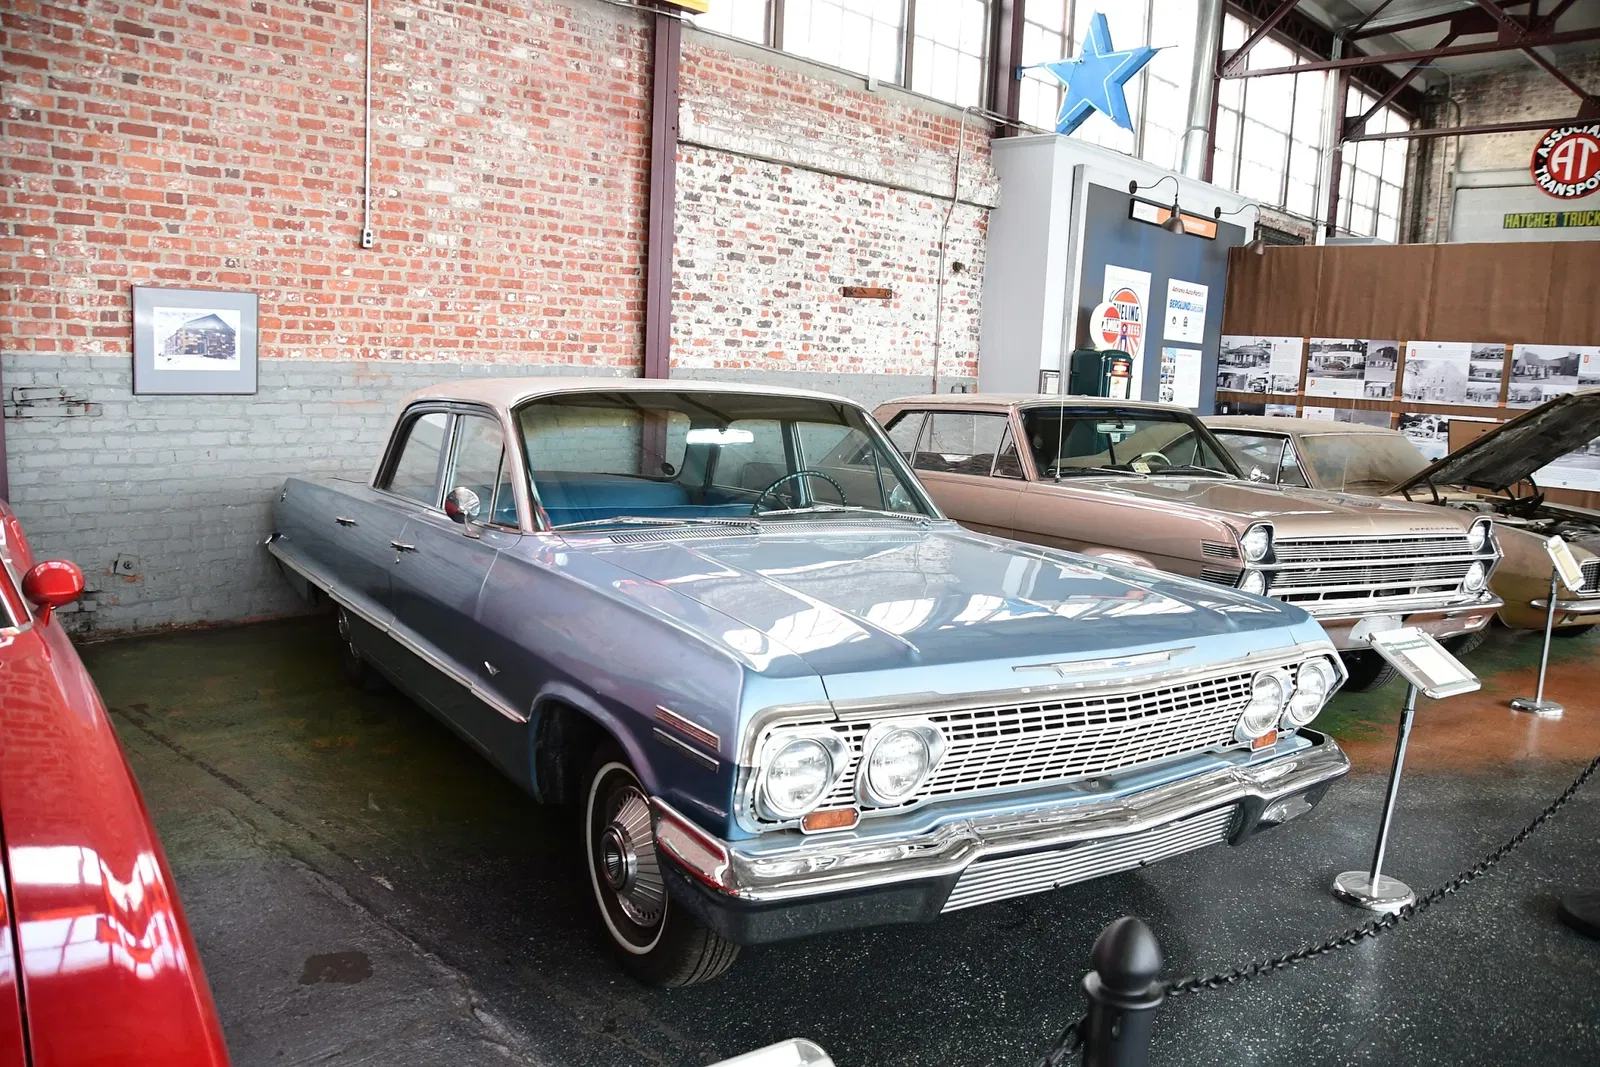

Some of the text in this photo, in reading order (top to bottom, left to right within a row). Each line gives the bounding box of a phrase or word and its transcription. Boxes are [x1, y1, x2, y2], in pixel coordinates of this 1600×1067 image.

[1537, 124, 1600, 158] ASSOCIA
[1551, 137, 1599, 181] AT
[1504, 212, 1557, 229] HATCHER
